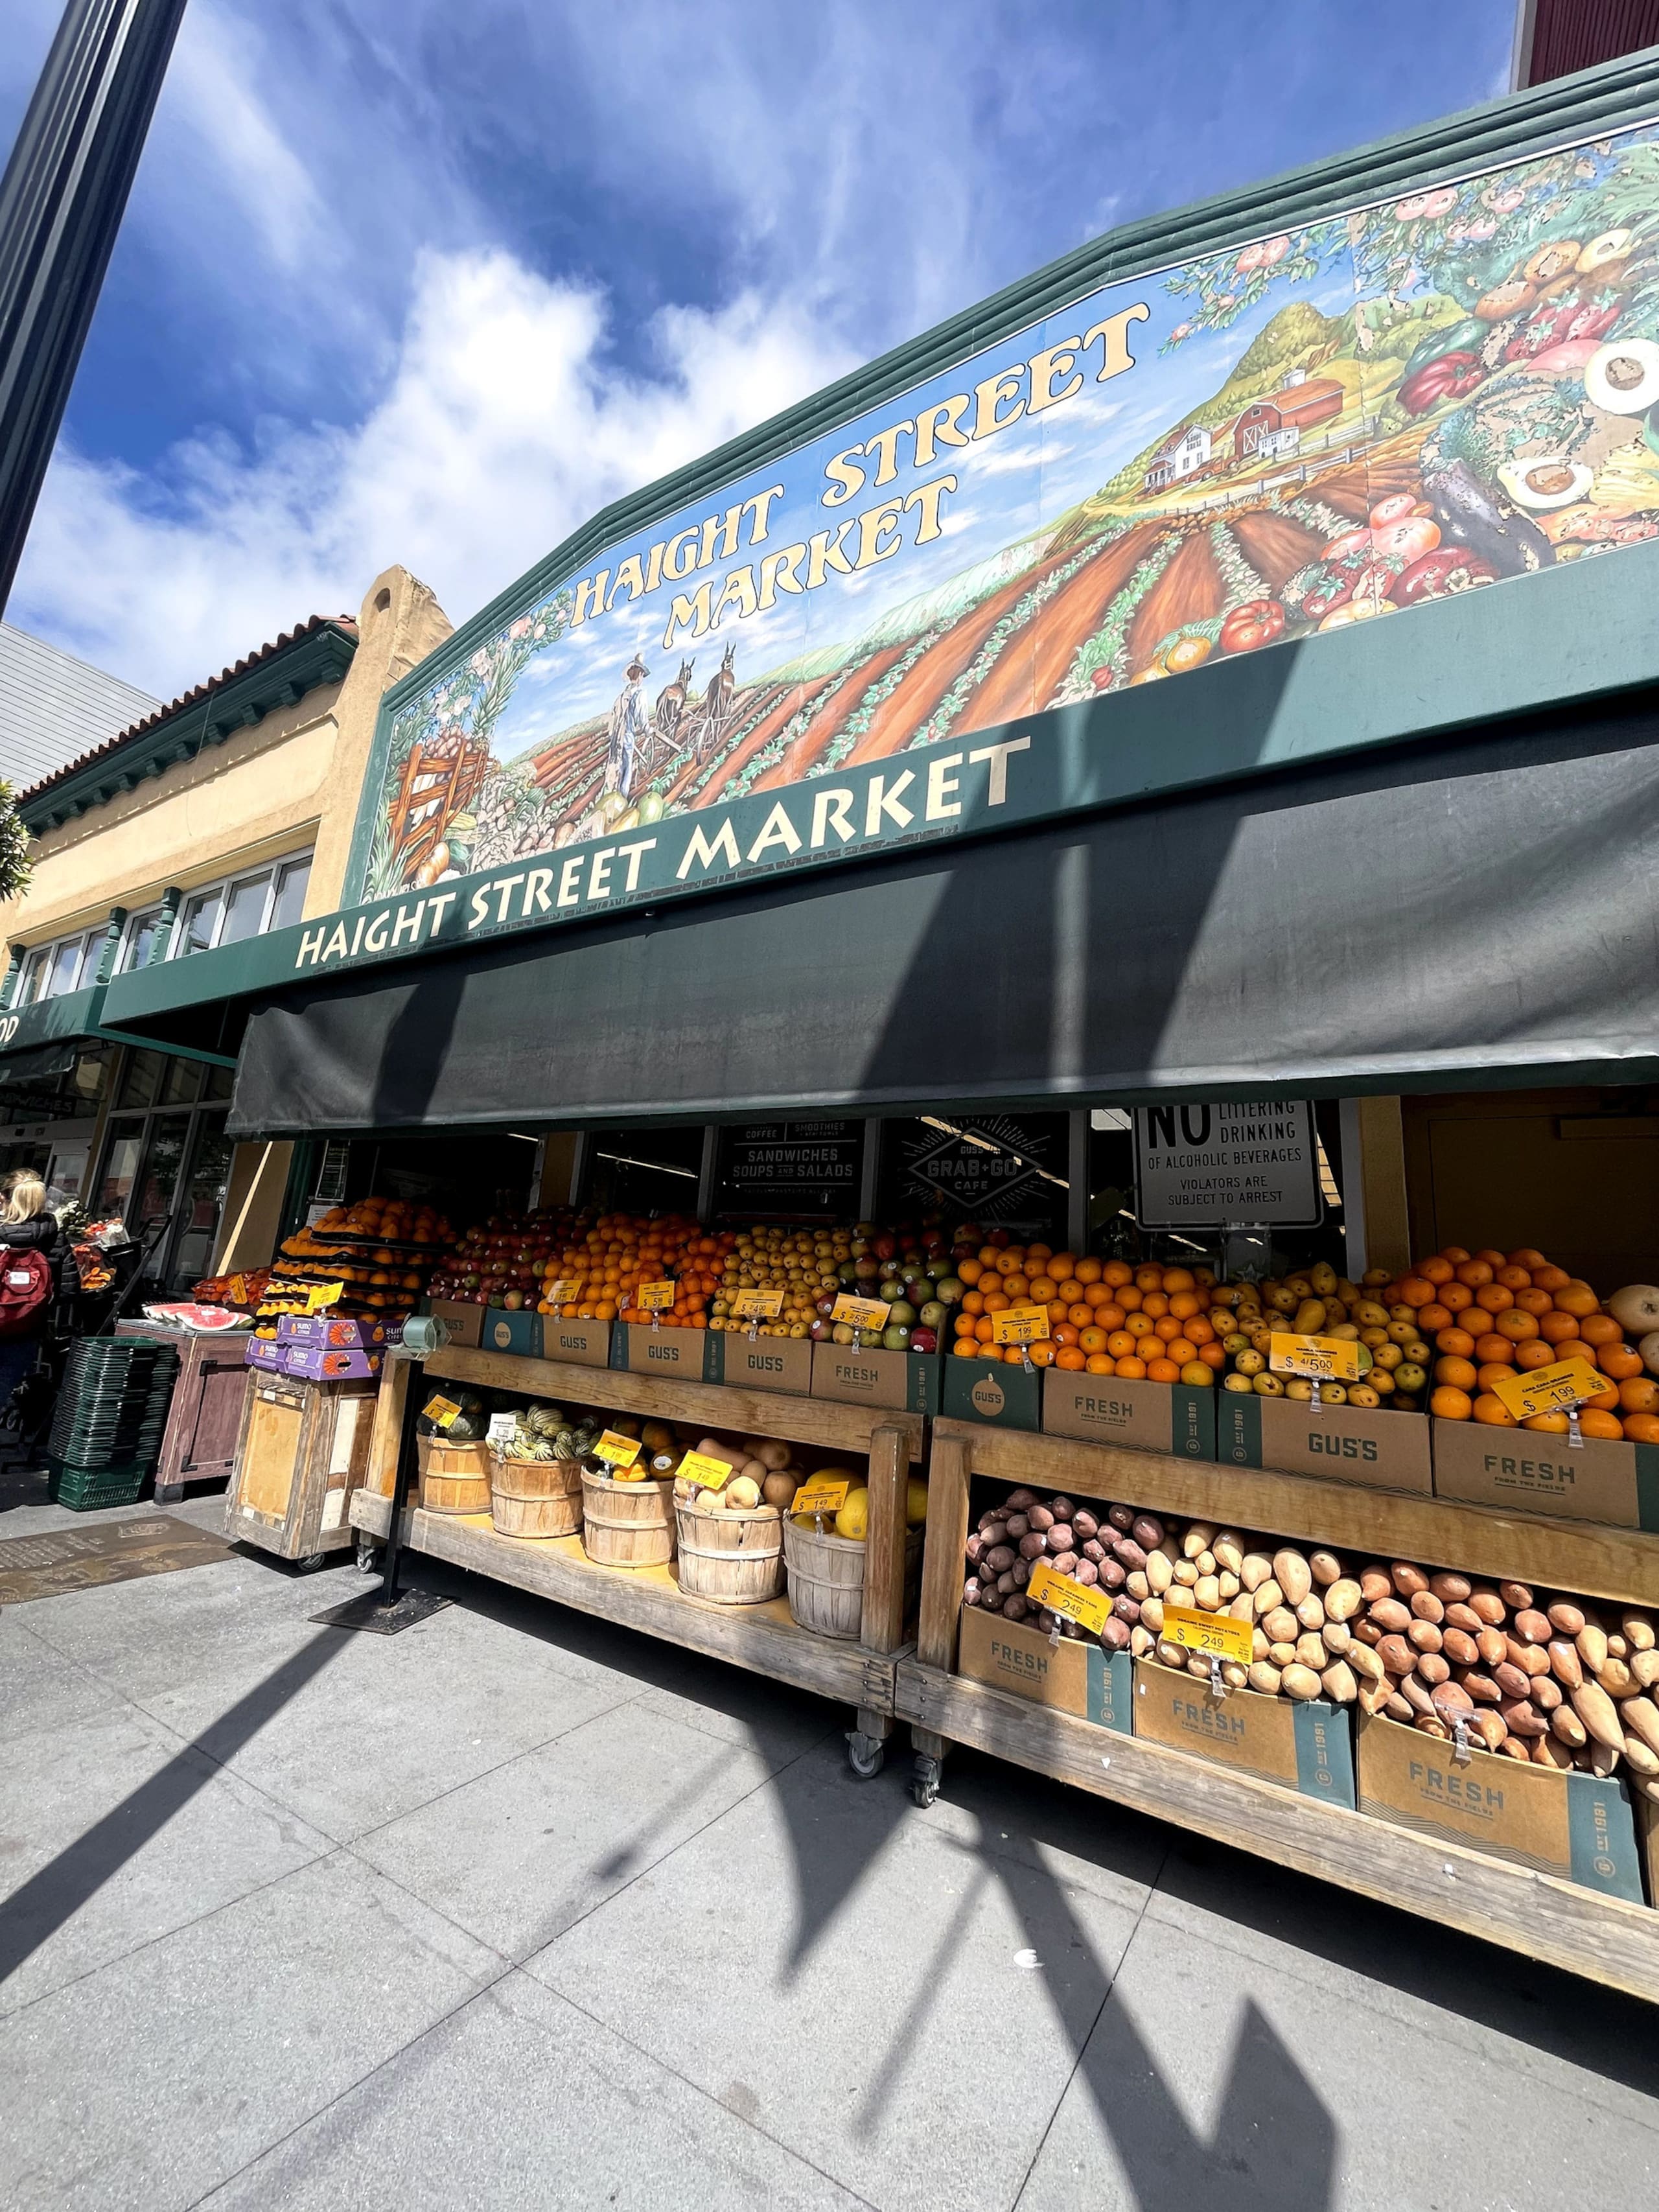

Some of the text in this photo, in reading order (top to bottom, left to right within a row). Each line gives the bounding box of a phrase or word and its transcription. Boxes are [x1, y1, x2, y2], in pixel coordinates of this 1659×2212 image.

[570, 302, 1150, 629] HAIGHT STREET
[663, 474, 957, 649] MARKET
[295, 736, 1032, 969] HAIGHT STREET MARKET
[795, 1122, 845, 1132] SMOOTHIES
[1147, 1102, 1295, 1149] NO LITTERING
[1220, 1121, 1296, 1144] DRINKING
[746, 1130, 777, 1139] COFFEE
[748, 1148, 839, 1162] SANDWICHES
[1148, 1147, 1302, 1170] OF ALCOHOLIC BEVERAGES
[732, 1165, 774, 1177] SOUPS
[797, 1163, 853, 1177] SALADS
[954, 1181, 988, 1190] CAFE
[1180, 1175, 1268, 1191] VIOLATORS ARE
[1168, 1191, 1283, 1205] SUBJECT TO ARREST
[1285, 1356, 1293, 1368] $
[836, 1366, 878, 1382] FRESH
[1074, 1396, 1133, 1417] FRESH
[1523, 1400, 1536, 1412] $
[1484, 1454, 1575, 1484] FRESH
[1537, 1483, 1566, 1491] FIELDS
[1040, 1589, 1049, 1601] $
[1177, 1628, 1185, 1641] $
[992, 1641, 1048, 1673] FRESH
[1172, 1699, 1245, 1736] FRESH
[1410, 1760, 1503, 1810] FRESH
[1594, 1801, 1607, 1834] 1981
